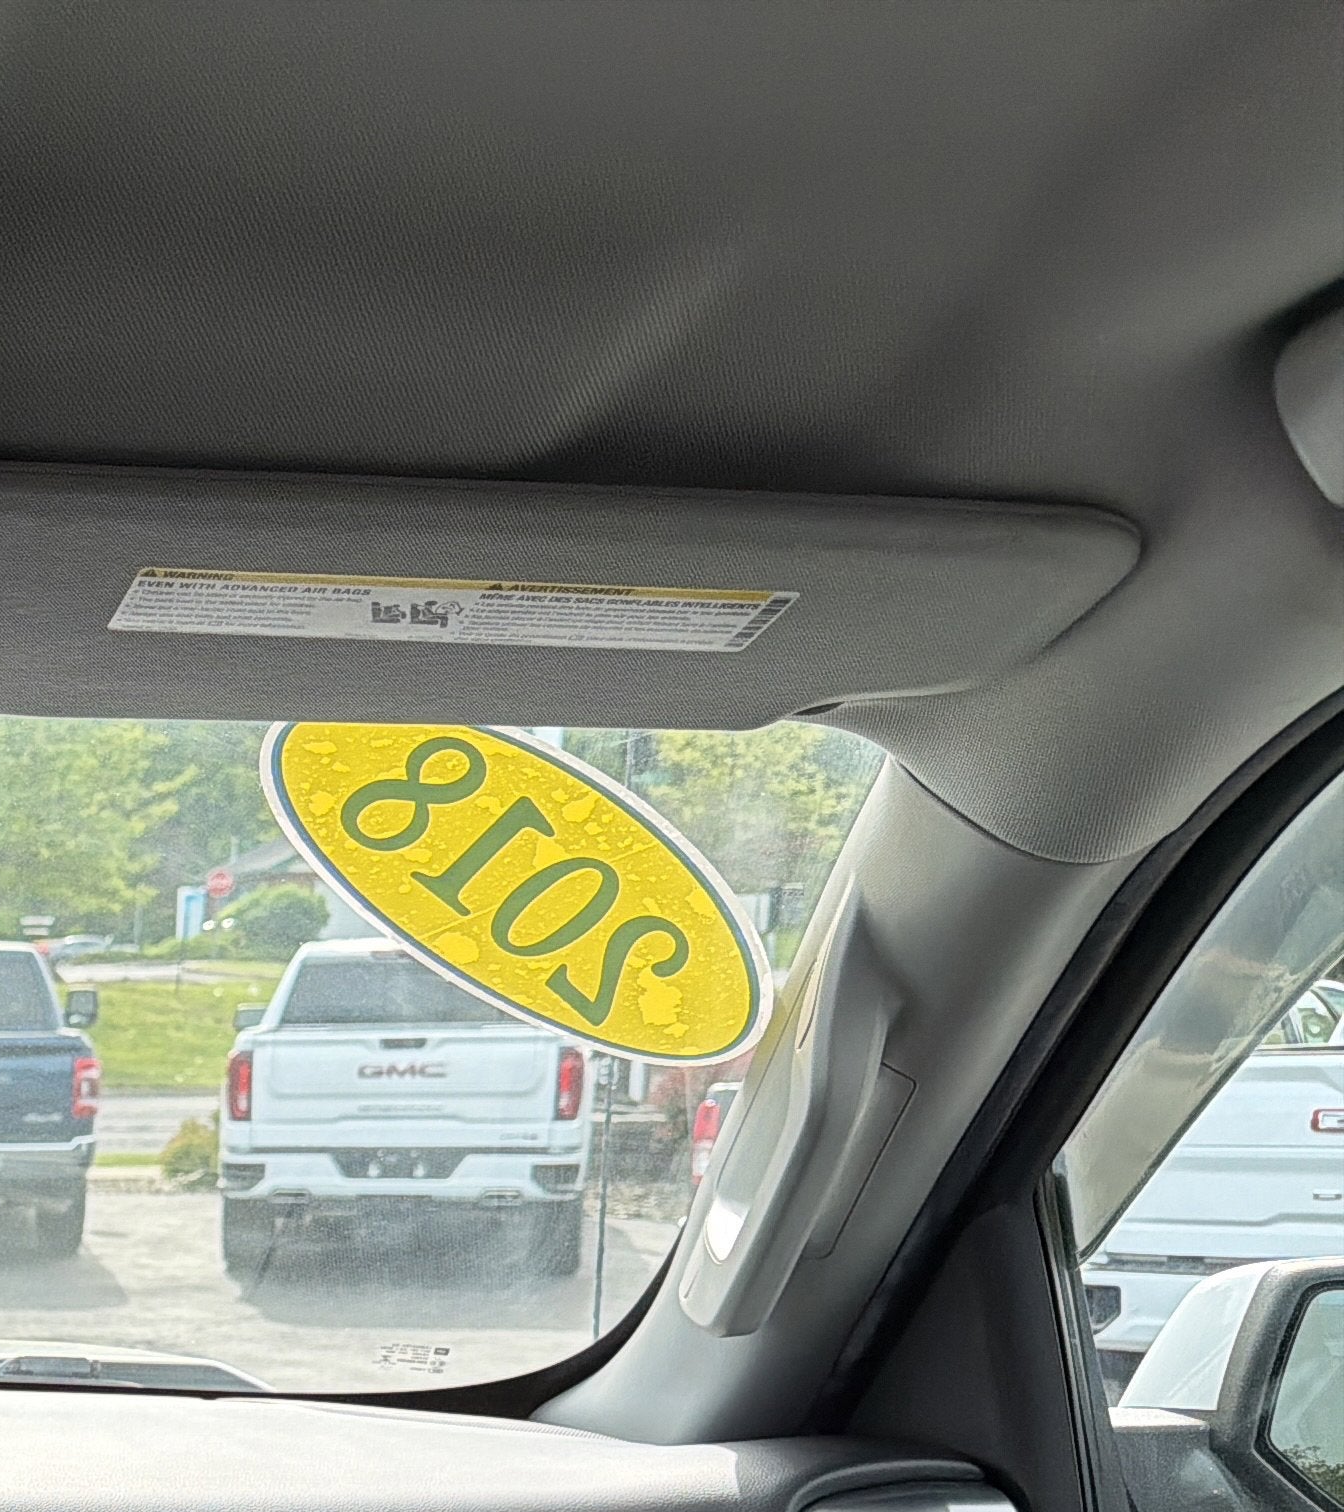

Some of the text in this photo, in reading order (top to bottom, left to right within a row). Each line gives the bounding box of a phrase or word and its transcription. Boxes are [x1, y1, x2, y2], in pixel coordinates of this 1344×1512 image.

[161, 570, 235, 582] WARNING
[137, 579, 372, 597] EVEN WITH ADVANCED AIR BAGS
[510, 583, 636, 597] AVERTISSEMENT
[516, 594, 547, 603] AVEC
[357, 1063, 449, 1080] GMC
